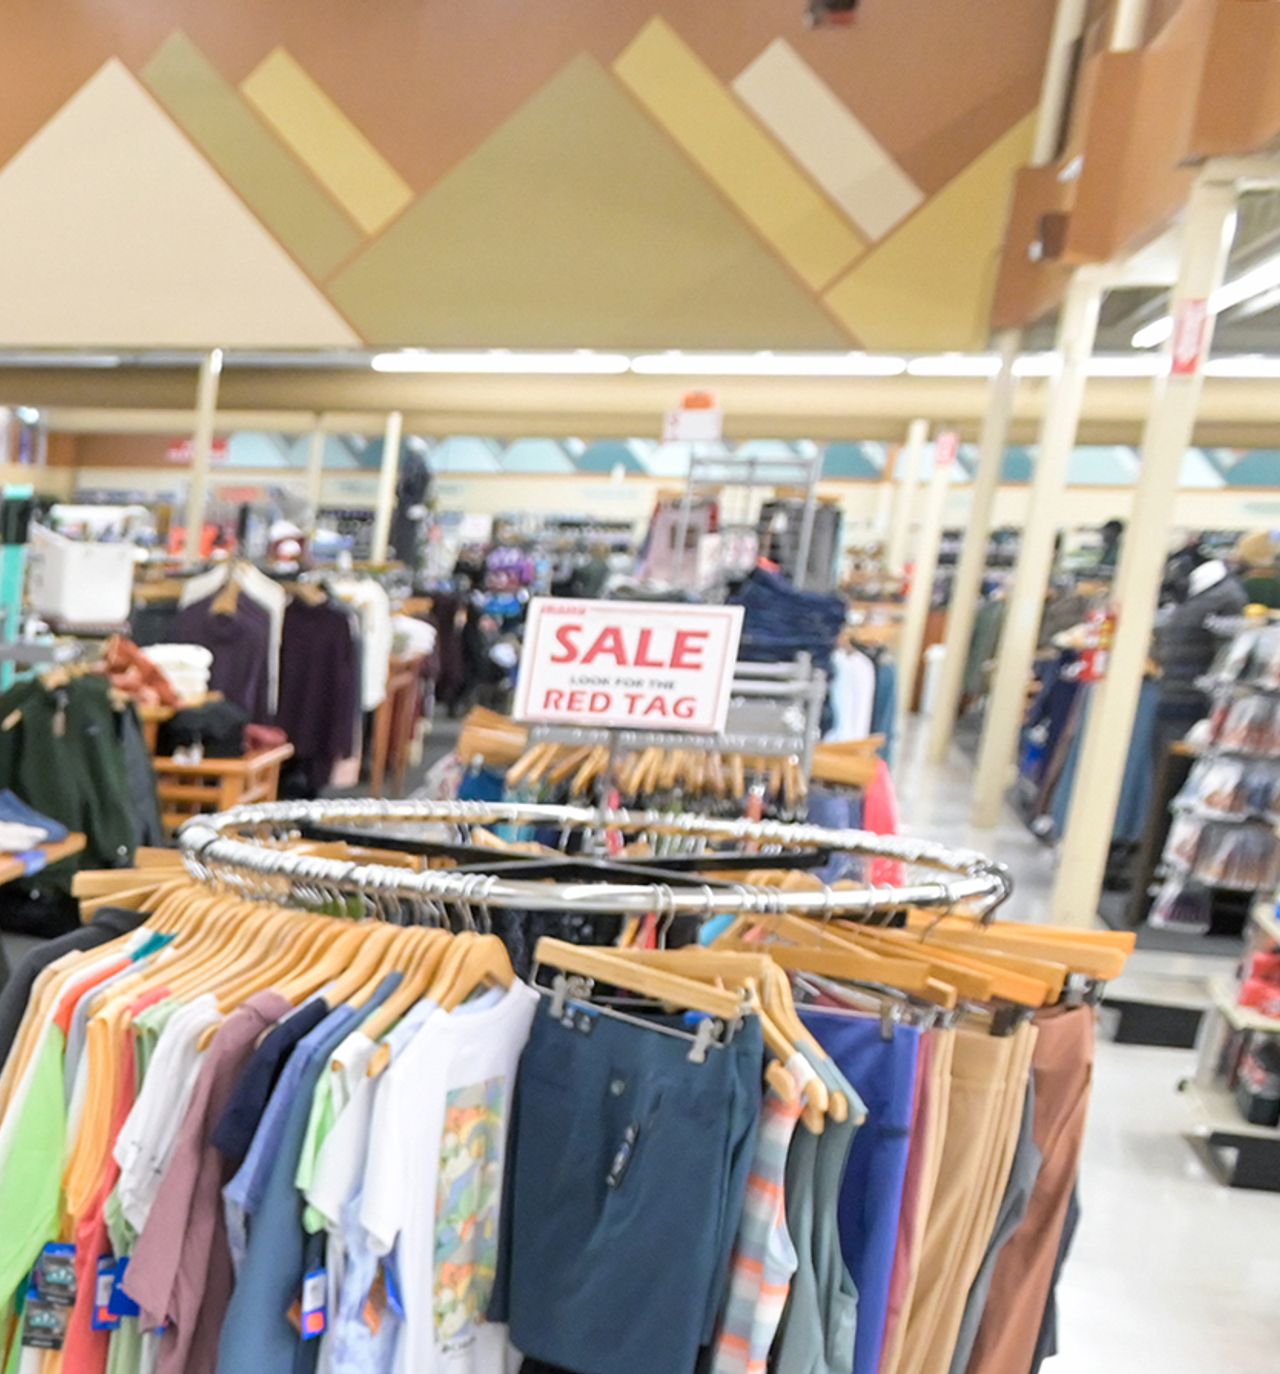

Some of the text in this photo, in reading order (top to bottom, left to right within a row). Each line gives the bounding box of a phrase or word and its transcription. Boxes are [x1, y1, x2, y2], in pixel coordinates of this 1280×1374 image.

[550, 624, 710, 671] SALE
[570, 675, 677, 690] LOOK FOR THE
[542, 689, 698, 719] RED TAG
